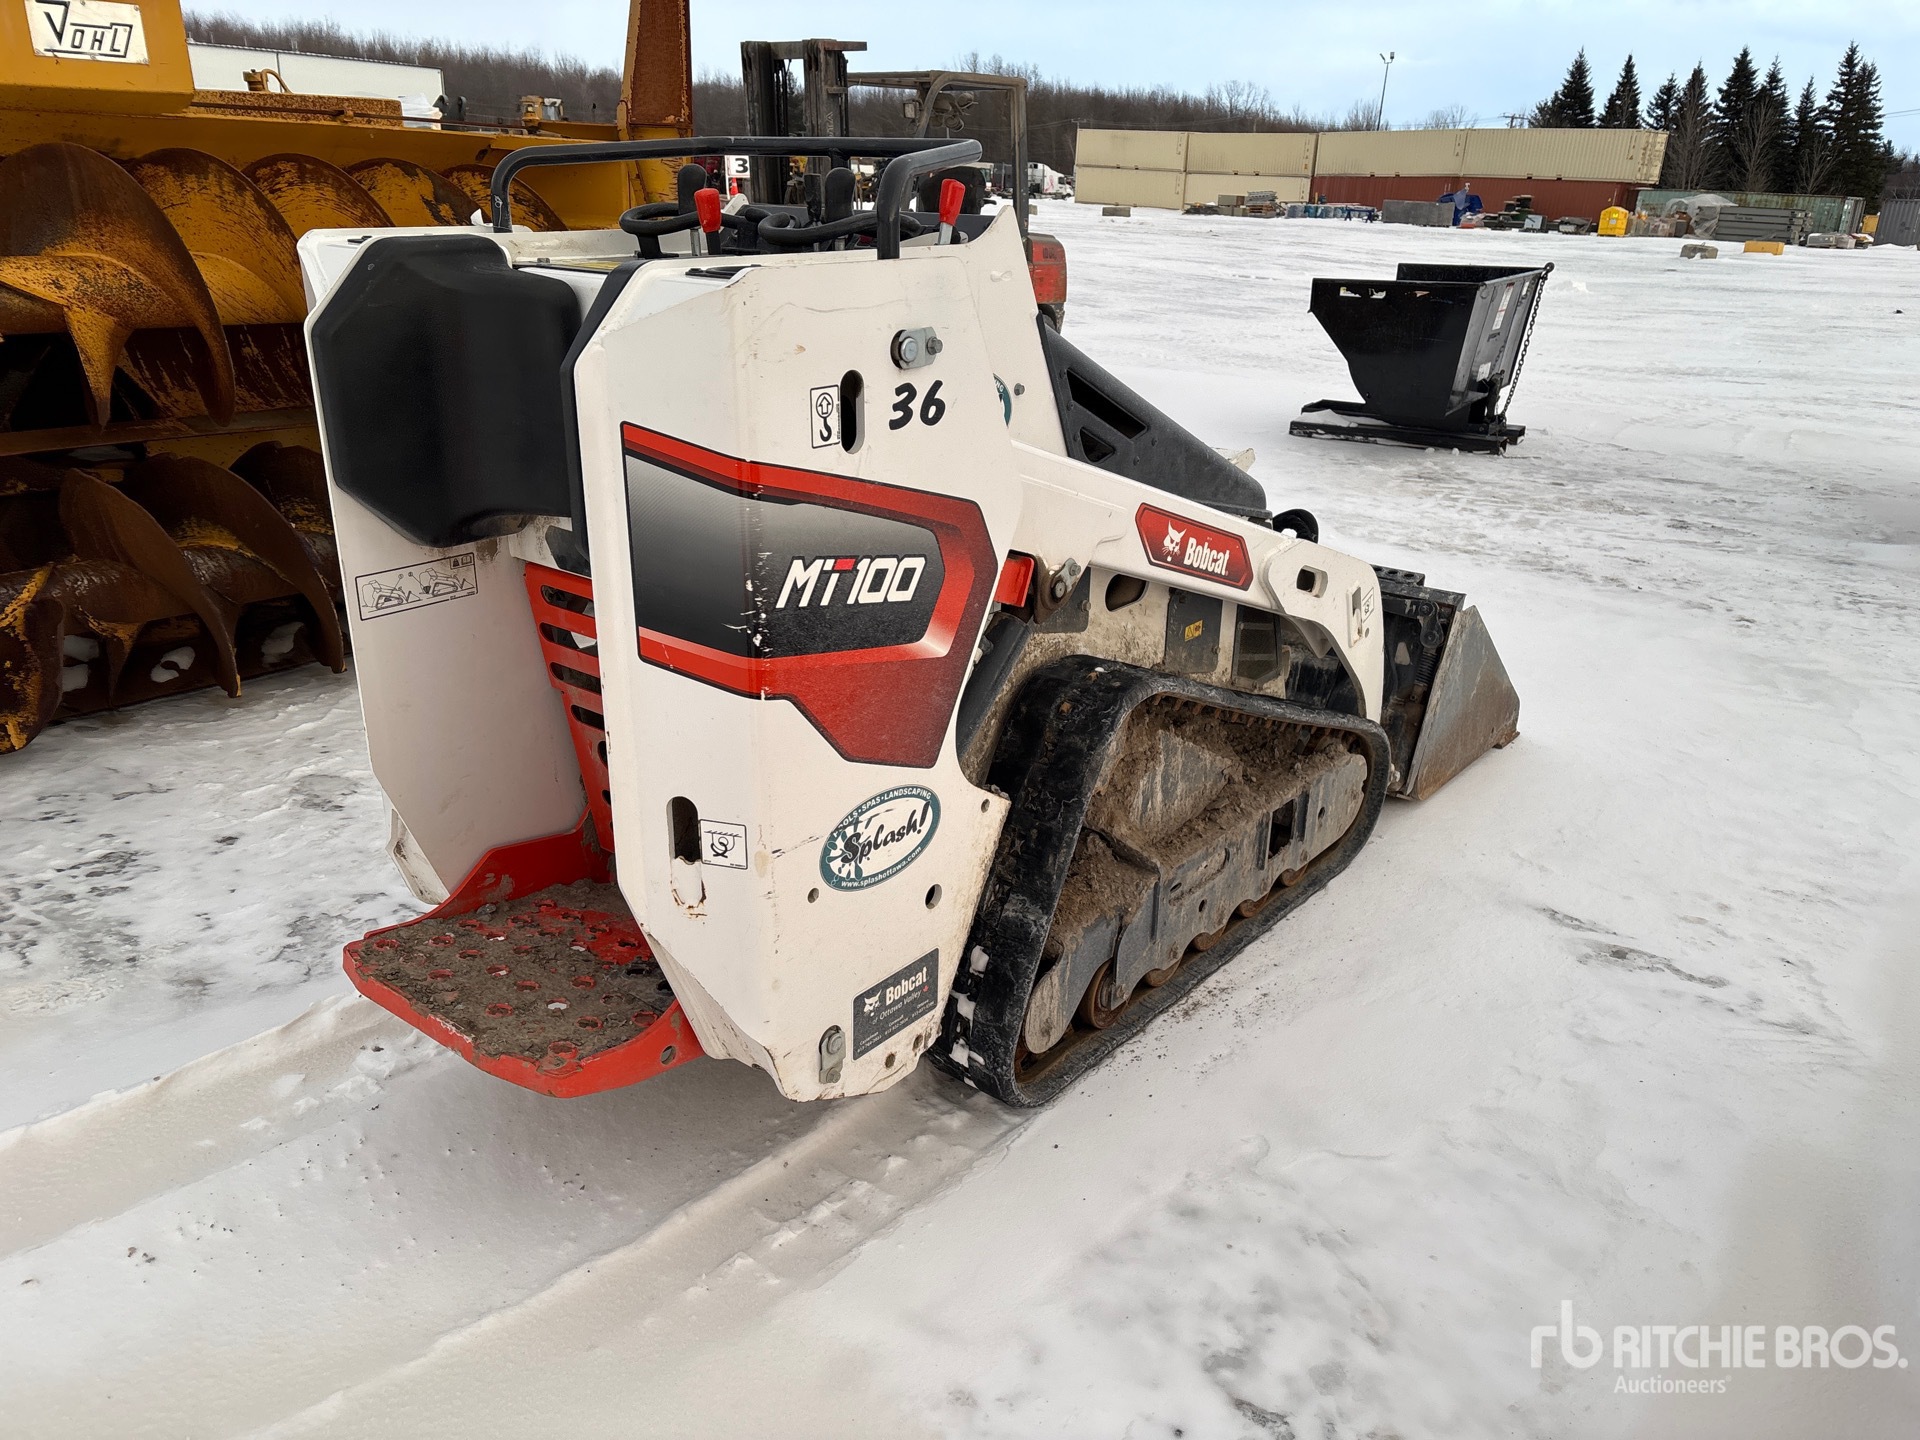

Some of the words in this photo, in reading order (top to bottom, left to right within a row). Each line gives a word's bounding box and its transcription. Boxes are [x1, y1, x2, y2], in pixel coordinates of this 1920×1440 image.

[735, 158, 749, 173] 3
[888, 379, 946, 431] 36
[1183, 536, 1230, 577] Bobcat
[775, 556, 926, 609] MT100
[861, 796, 881, 813] SPAS
[883, 787, 932, 801] LANDSCAPING
[840, 800, 931, 865] Splash!
[841, 846, 922, 888] www.splashottawa.com
[879, 999, 903, 1020] Ottawa
[903, 988, 922, 1005] Valley
[885, 966, 928, 1007] Bobcat
